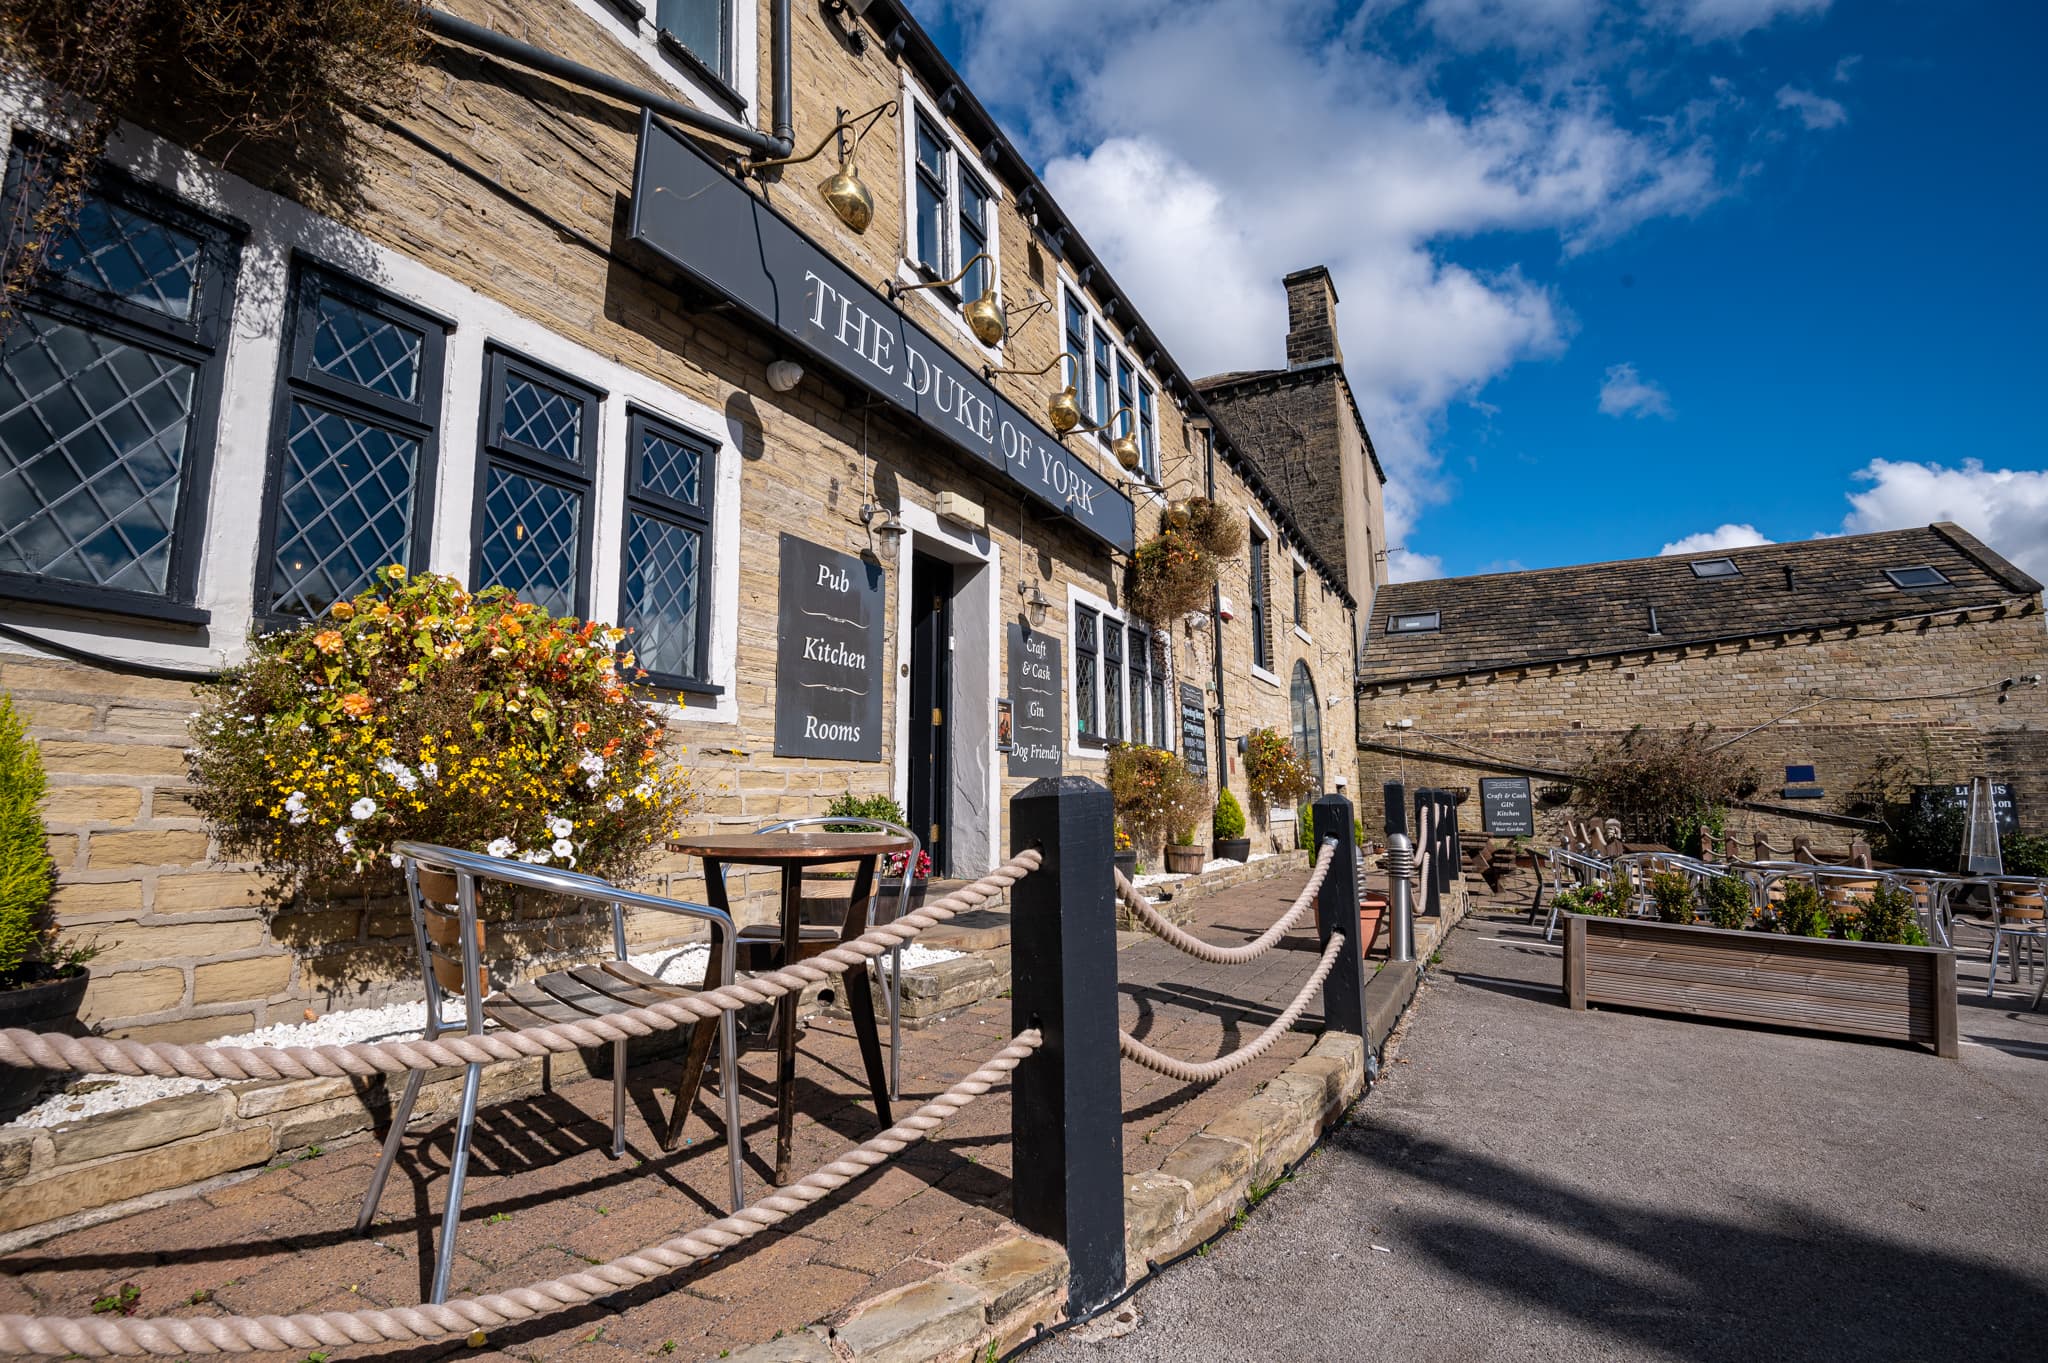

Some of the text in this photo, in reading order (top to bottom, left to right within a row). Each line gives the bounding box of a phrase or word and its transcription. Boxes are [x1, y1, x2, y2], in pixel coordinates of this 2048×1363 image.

[805, 270, 1095, 516] THE DUKE OF YORK
[816, 564, 850, 593] Pub
[802, 636, 867, 670] Kitchen
[1026, 638, 1046, 659] Craft
[1022, 661, 1051, 681] & Cask
[1030, 702, 1044, 718] Gin
[804, 715, 861, 743] Rooms
[1012, 742, 1061, 765] Dog Friendly
[1998, 800, 2012, 808] on
